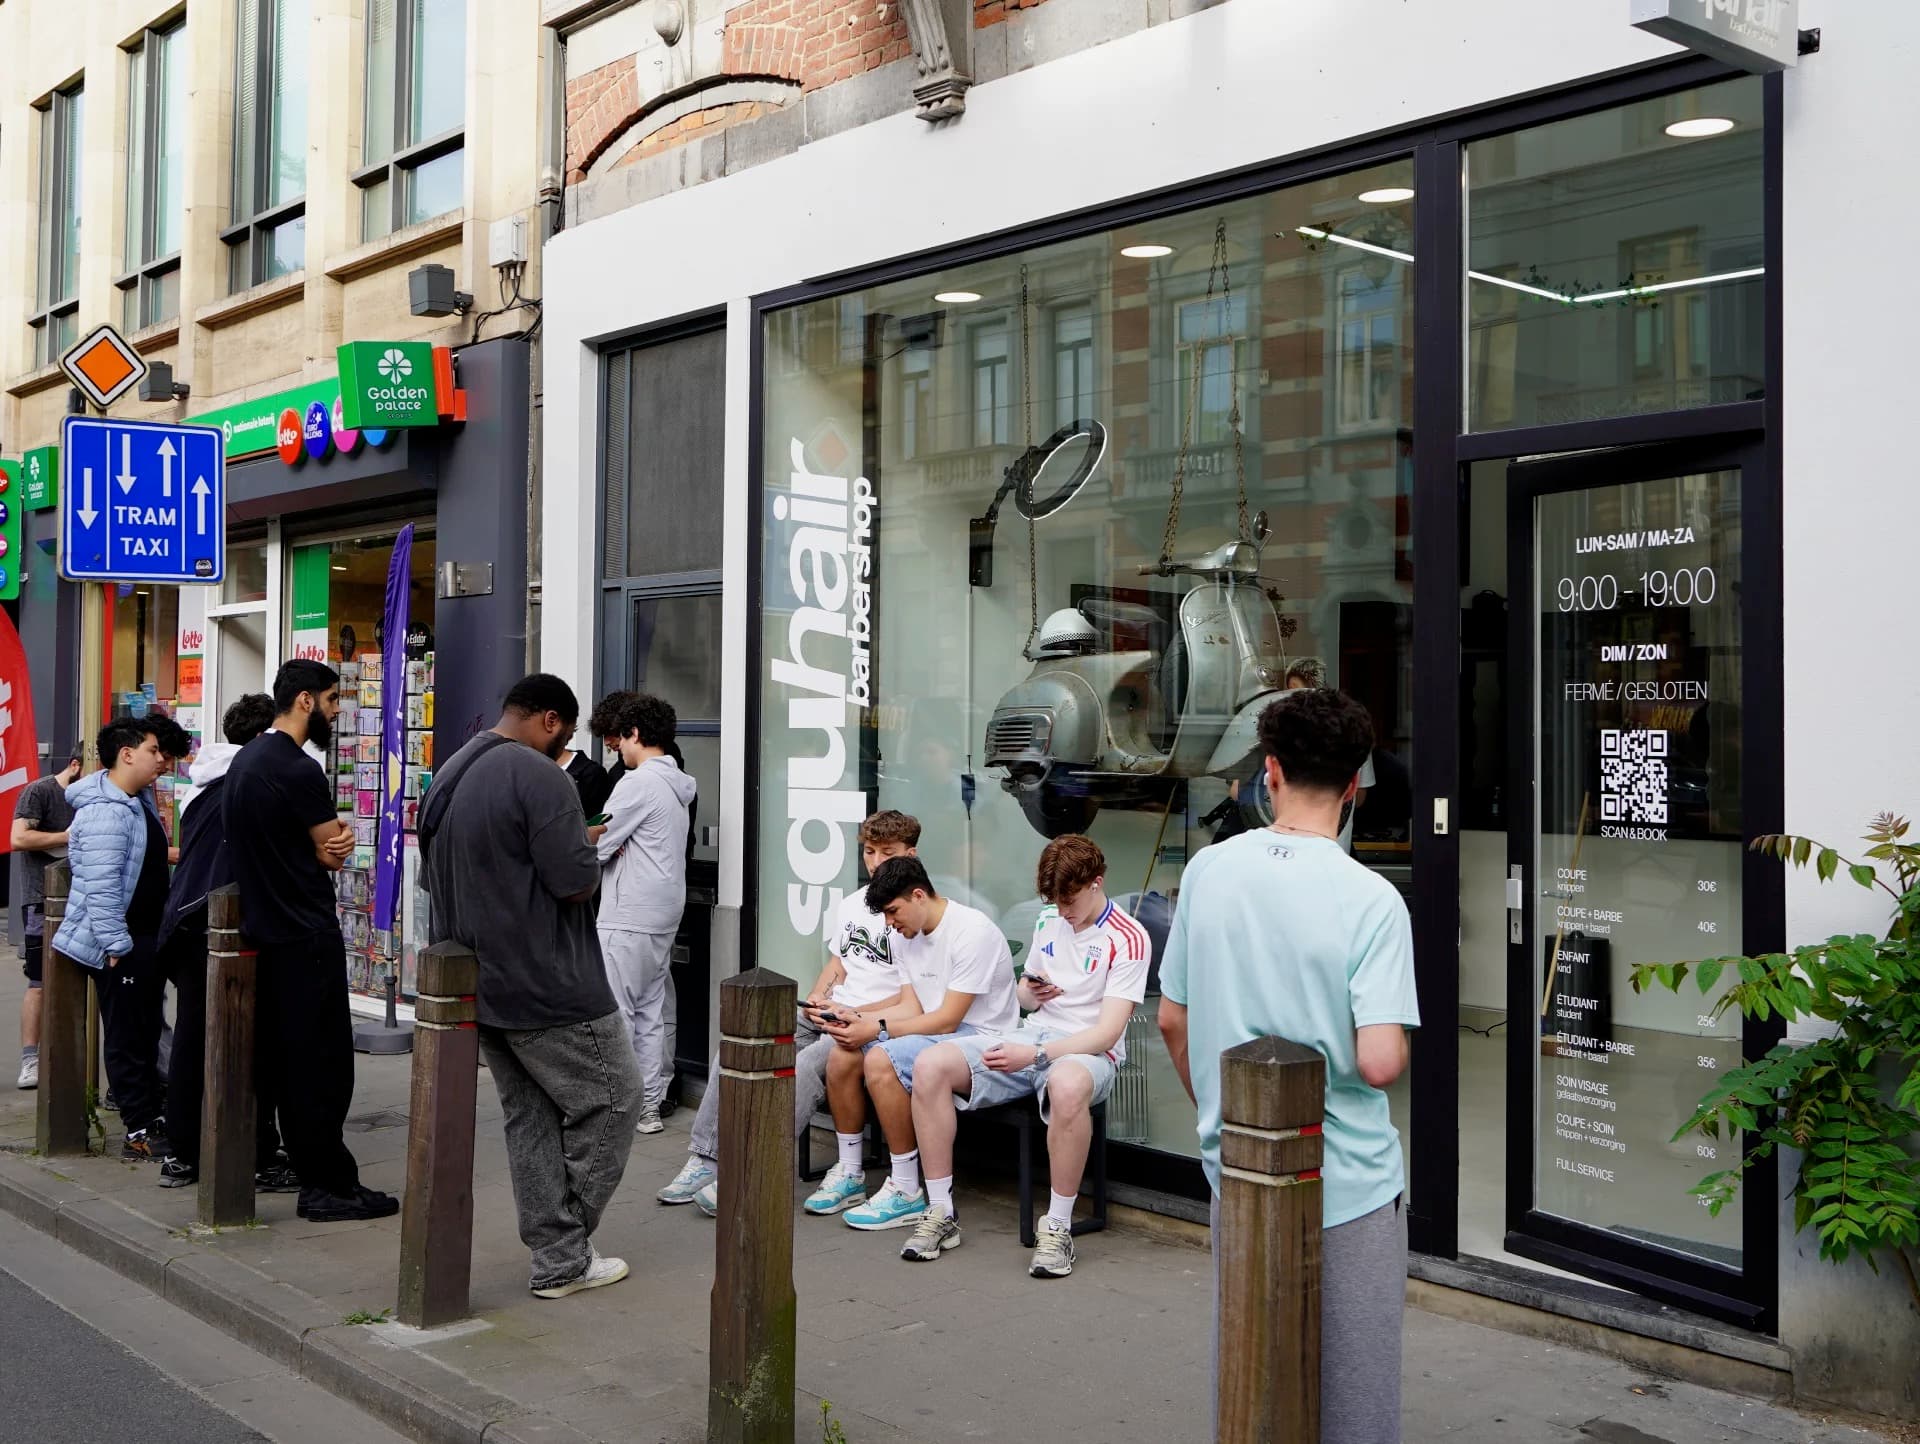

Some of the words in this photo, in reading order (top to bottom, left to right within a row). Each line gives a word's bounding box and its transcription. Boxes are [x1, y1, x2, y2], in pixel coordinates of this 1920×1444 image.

[368, 386, 428, 400] Golden
[376, 401, 421, 413] palace
[114, 505, 176, 526] TRAM
[120, 537, 169, 557] TAXI
[1576, 532, 1637, 554] LUN-SAM
[1648, 527, 1694, 547] MA-ZA
[846, 476, 878, 708] barbershop
[1558, 574, 1617, 612] 9:00
[1639, 567, 1716, 607] 19:00
[1601, 645, 1628, 662] DIM
[1637, 644, 1667, 660] ZON
[771, 437, 867, 942] squhair
[1565, 679, 1613, 701] FERMÉ
[1624, 680, 1708, 701] GESLOTEN
[1601, 825, 1628, 839] SCAN
[1637, 828, 1668, 841] BOOK
[1557, 868, 1587, 881] COUPE
[1557, 881, 1584, 893] knippen
[1697, 880, 1717, 893] 30€
[1557, 906, 1587, 919] COUPE
[1594, 909, 1623, 923] BARBE
[1557, 919, 1584, 931] knippen
[1590, 922, 1611, 934] baard
[1697, 921, 1717, 933] 40€
[1557, 950, 1590, 964] ENFANT
[1557, 963, 1572, 974] kind
[1557, 993, 1599, 1011] ÉTUDIANT
[1556, 1008, 1582, 1021] student
[1697, 1014, 1716, 1028] 25€
[1557, 1030, 1598, 1049] ÉTUDIANT
[1605, 1040, 1635, 1056] BARBE
[1556, 1046, 1582, 1059] student
[1588, 1052, 1608, 1063] baard
[1697, 1055, 1716, 1069] 35€
[1557, 1075, 1577, 1089] SOIN
[1577, 1079, 1608, 1095] VISAGE
[1557, 1089, 1616, 1111] gelaatsverzorging
[1557, 1113, 1586, 1129] COUPE
[1593, 1121, 1614, 1136] SOIN
[1557, 1126, 1583, 1142] knippen
[1589, 1135, 1625, 1153] verzorging
[1697, 1145, 1716, 1159] 60€
[1557, 1158, 1577, 1173] FULL
[1577, 1163, 1614, 1182] SERVICE
